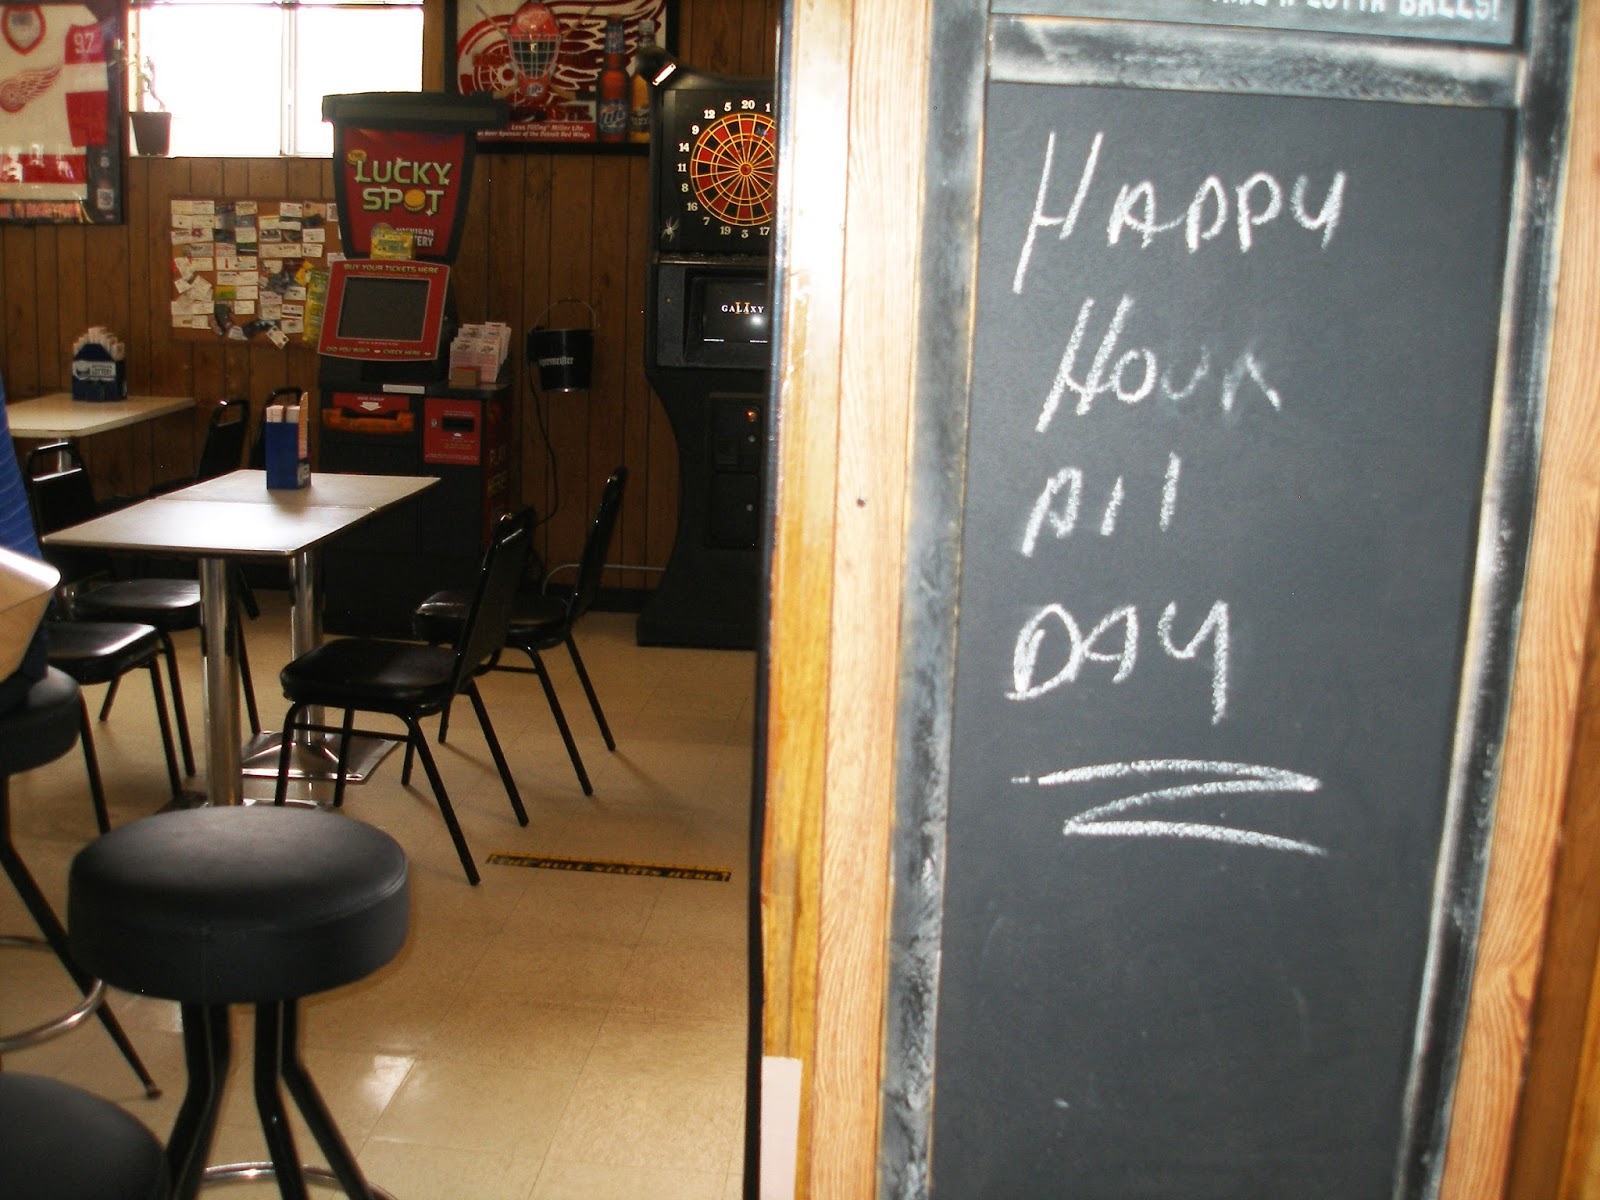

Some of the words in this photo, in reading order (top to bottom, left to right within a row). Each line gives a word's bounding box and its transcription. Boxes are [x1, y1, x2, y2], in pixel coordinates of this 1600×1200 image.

[1398, 0, 1499, 24] BALLS!
[75, 32, 95, 53] 97
[724, 102, 732, 112] 5
[741, 100, 755, 110] 20
[765, 103, 771, 113] 1
[703, 110, 716, 120] 12
[573, 131, 590, 139] Wings
[692, 125, 700, 135] 9
[679, 143, 690, 153] 14
[355, 158, 452, 186] LUCKY
[677, 163, 687, 172] 11
[681, 183, 689, 193] 8
[362, 187, 445, 213] SPOT
[687, 202, 698, 211] 16
[703, 217, 711, 225] 7
[720, 226, 731, 235] 19
[741, 229, 749, 238] 3
[759, 227, 770, 236] 17
[343, 263, 360, 271] BUY
[362, 264, 383, 272] YOUR
[385, 265, 416, 273] TICKETS
[418, 266, 439, 274] HERE
[721, 304, 764, 313] GALAXY
[1004, 599, 1230, 726] DAY
